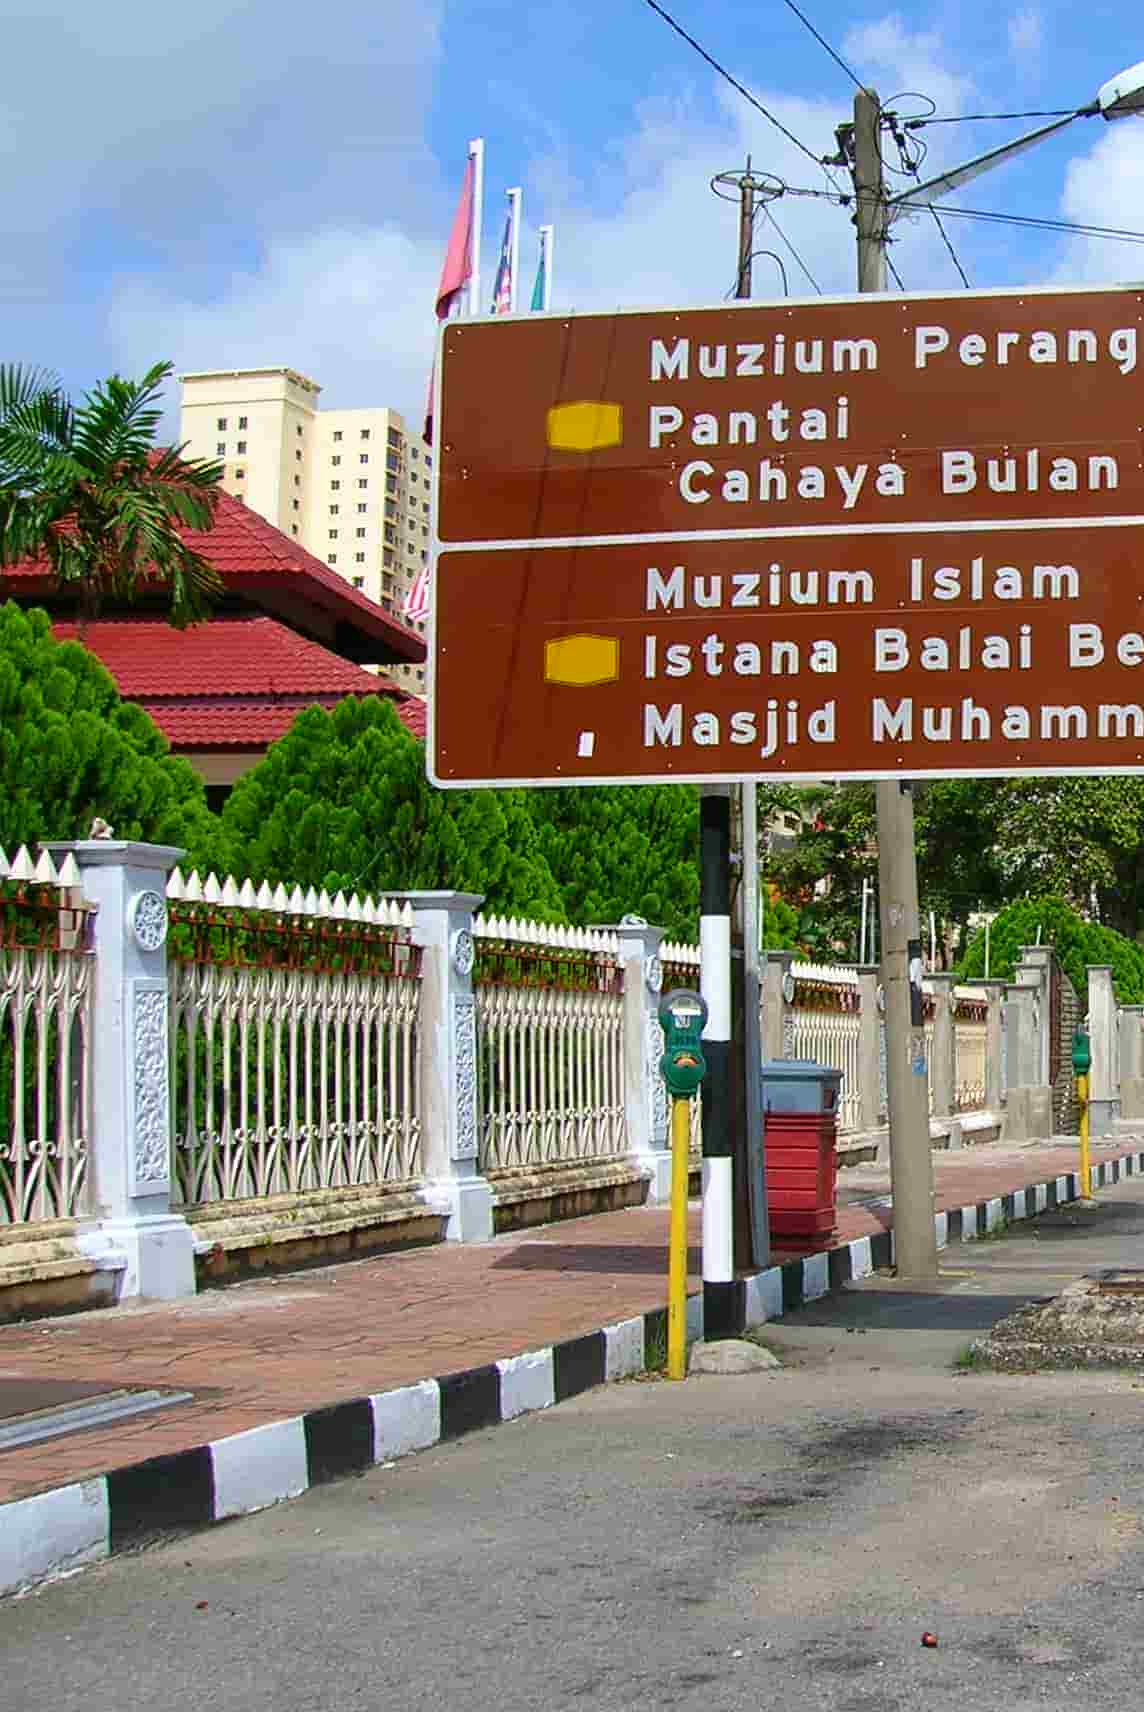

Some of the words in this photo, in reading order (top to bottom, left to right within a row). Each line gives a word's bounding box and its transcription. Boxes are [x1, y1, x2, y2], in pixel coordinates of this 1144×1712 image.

[650, 336, 877, 381] Muzium
[915, 325, 1137, 375] Perang
[649, 396, 849, 449] Pantai
[679, 459, 906, 509] Cahaya
[941, 448, 1118, 494] Bulan
[646, 563, 874, 610] Muzium
[911, 557, 1080, 601] Islam
[645, 634, 837, 678] Istana
[875, 623, 1031, 672] Balai
[644, 699, 835, 758] Masjid
